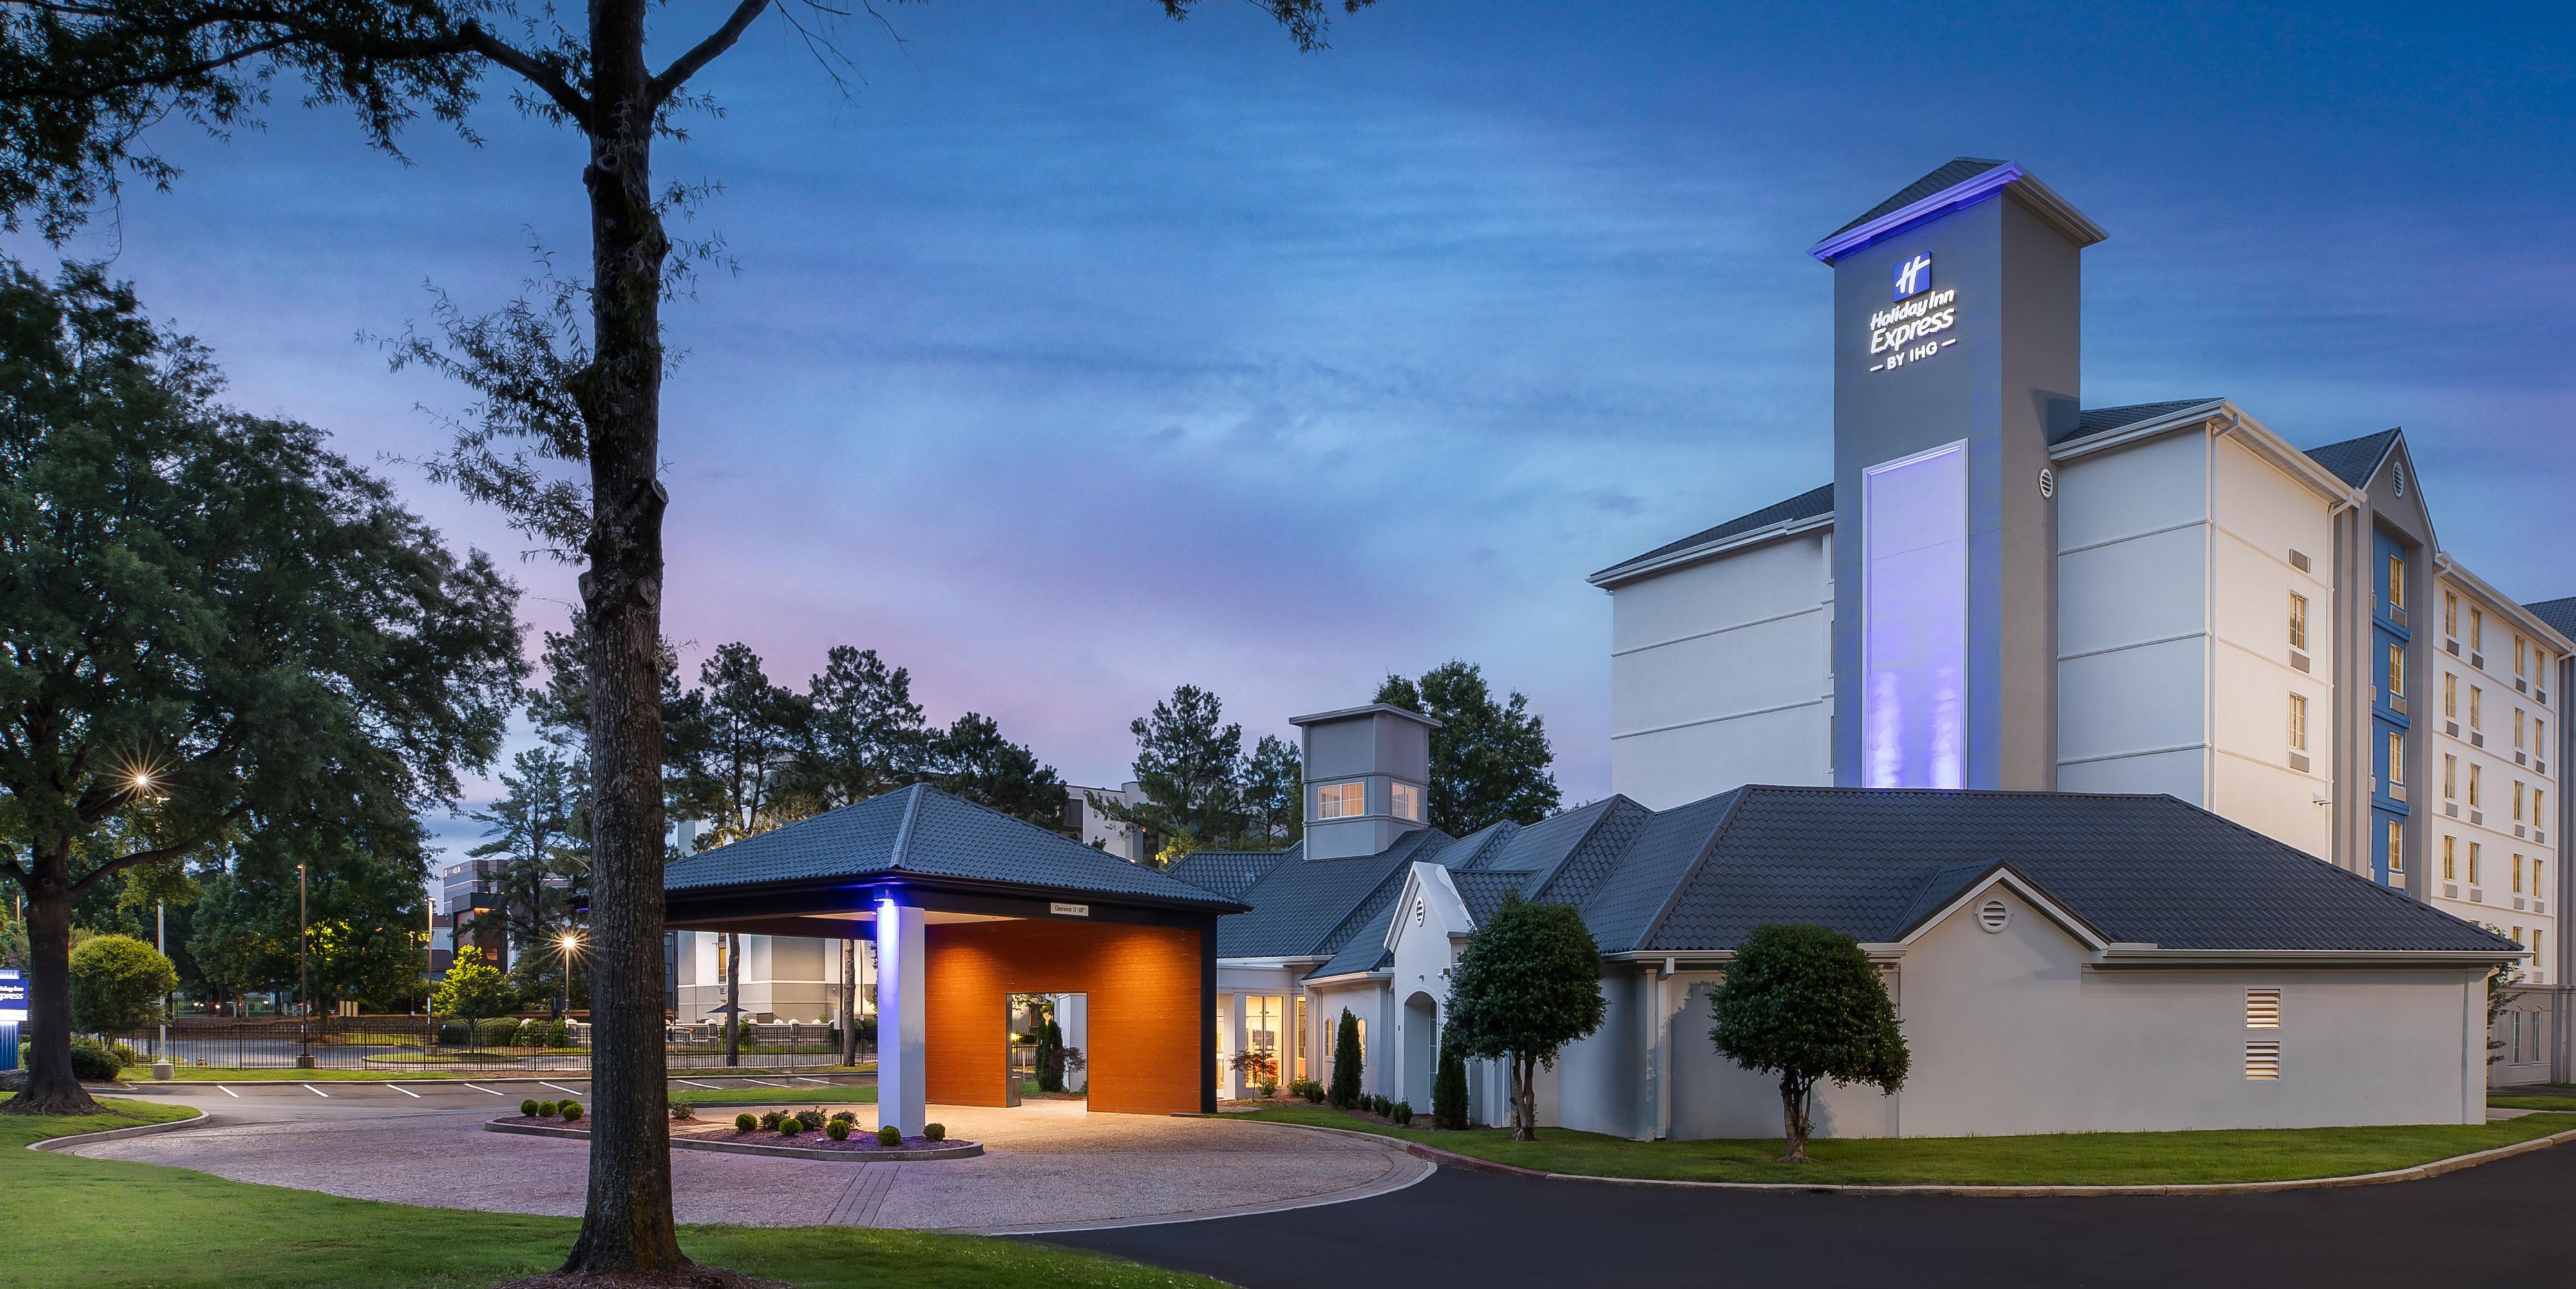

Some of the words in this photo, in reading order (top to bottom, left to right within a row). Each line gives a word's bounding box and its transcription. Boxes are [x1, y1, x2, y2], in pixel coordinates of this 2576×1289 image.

[1895, 256, 1930, 294] H
[1870, 301, 1927, 330] Holiday
[1929, 289, 1955, 309] Inn
[1870, 307, 1955, 354] Express
[1887, 352, 1905, 370] BY
[1909, 341, 1938, 362] IHG
